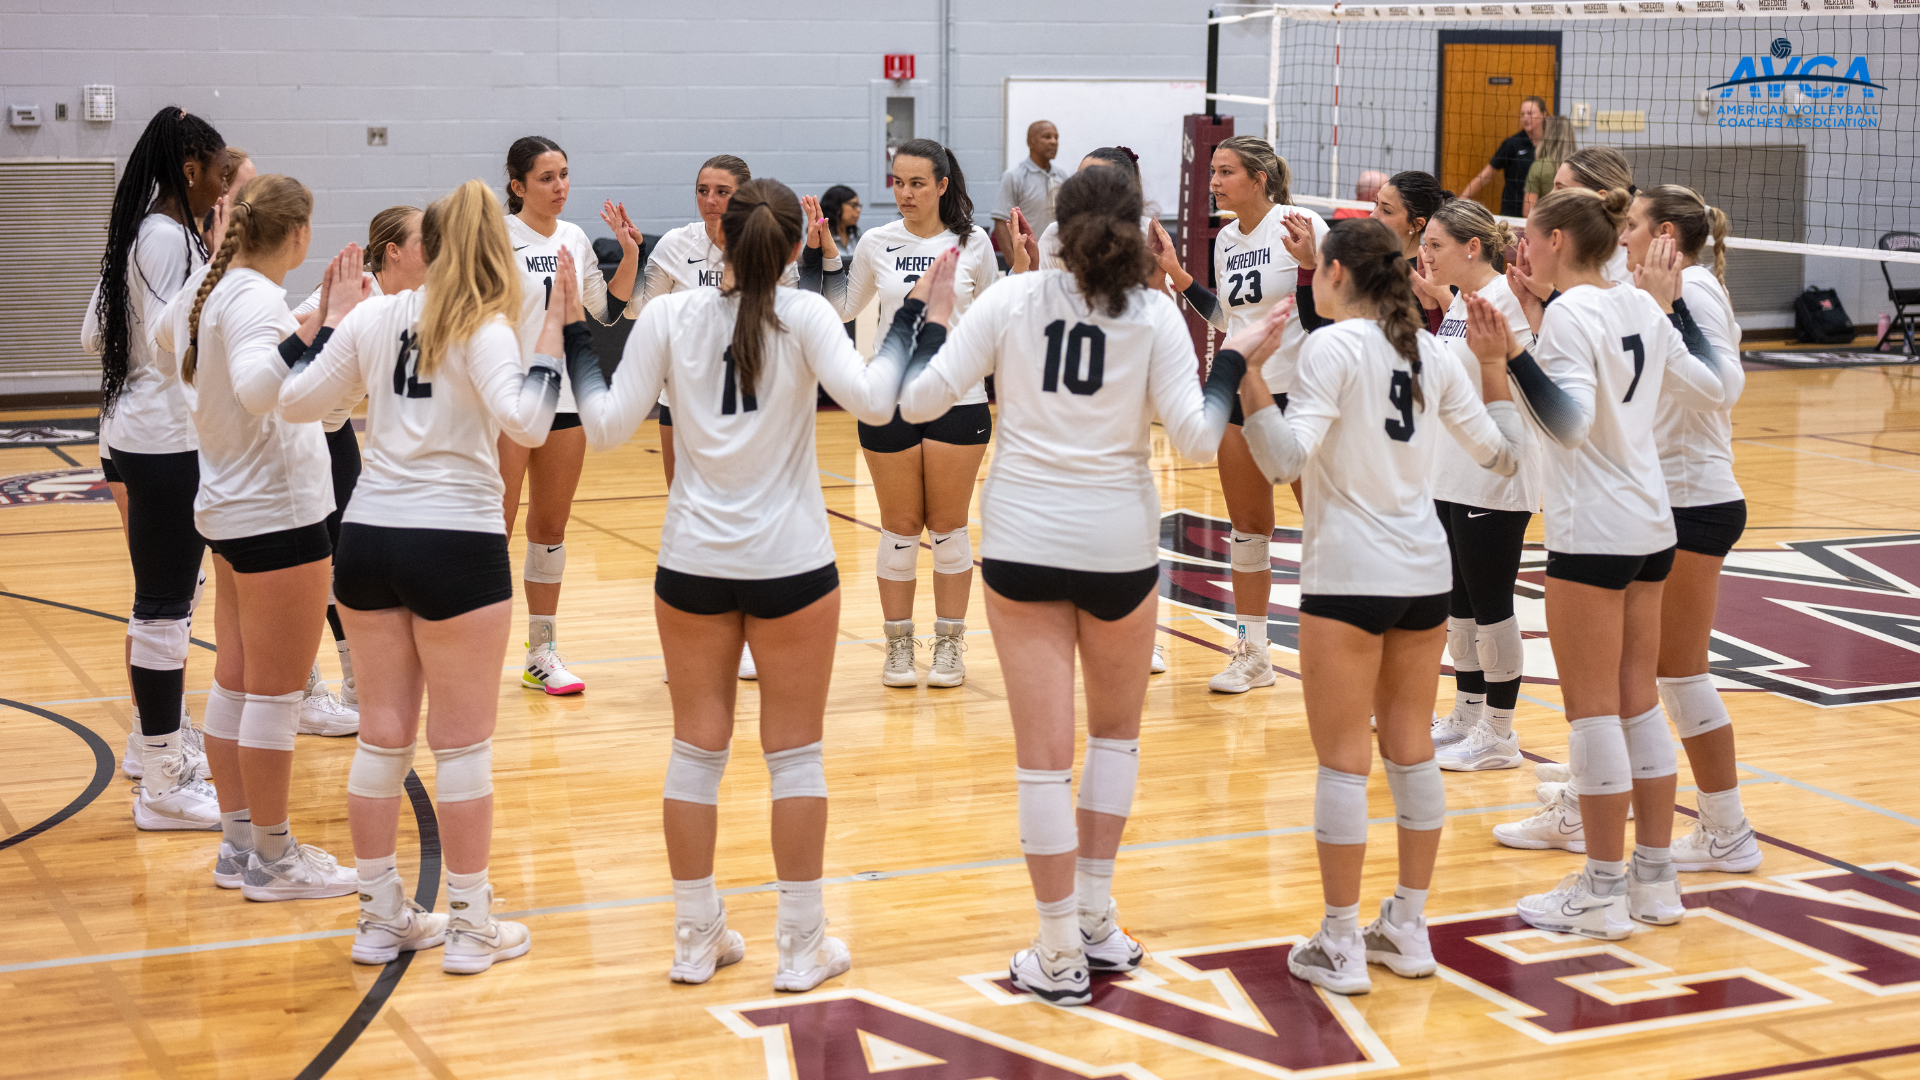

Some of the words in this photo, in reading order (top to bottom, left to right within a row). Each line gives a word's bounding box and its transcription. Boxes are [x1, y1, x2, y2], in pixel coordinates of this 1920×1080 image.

[526, 256, 559, 273] MERED
[895, 256, 937, 271] MERED
[1226, 247, 1271, 272] MEREDITH
[1228, 269, 1263, 307] 23
[1042, 319, 1106, 396] 10
[1621, 333, 1646, 404] 7
[1384, 369, 1416, 442] 9
